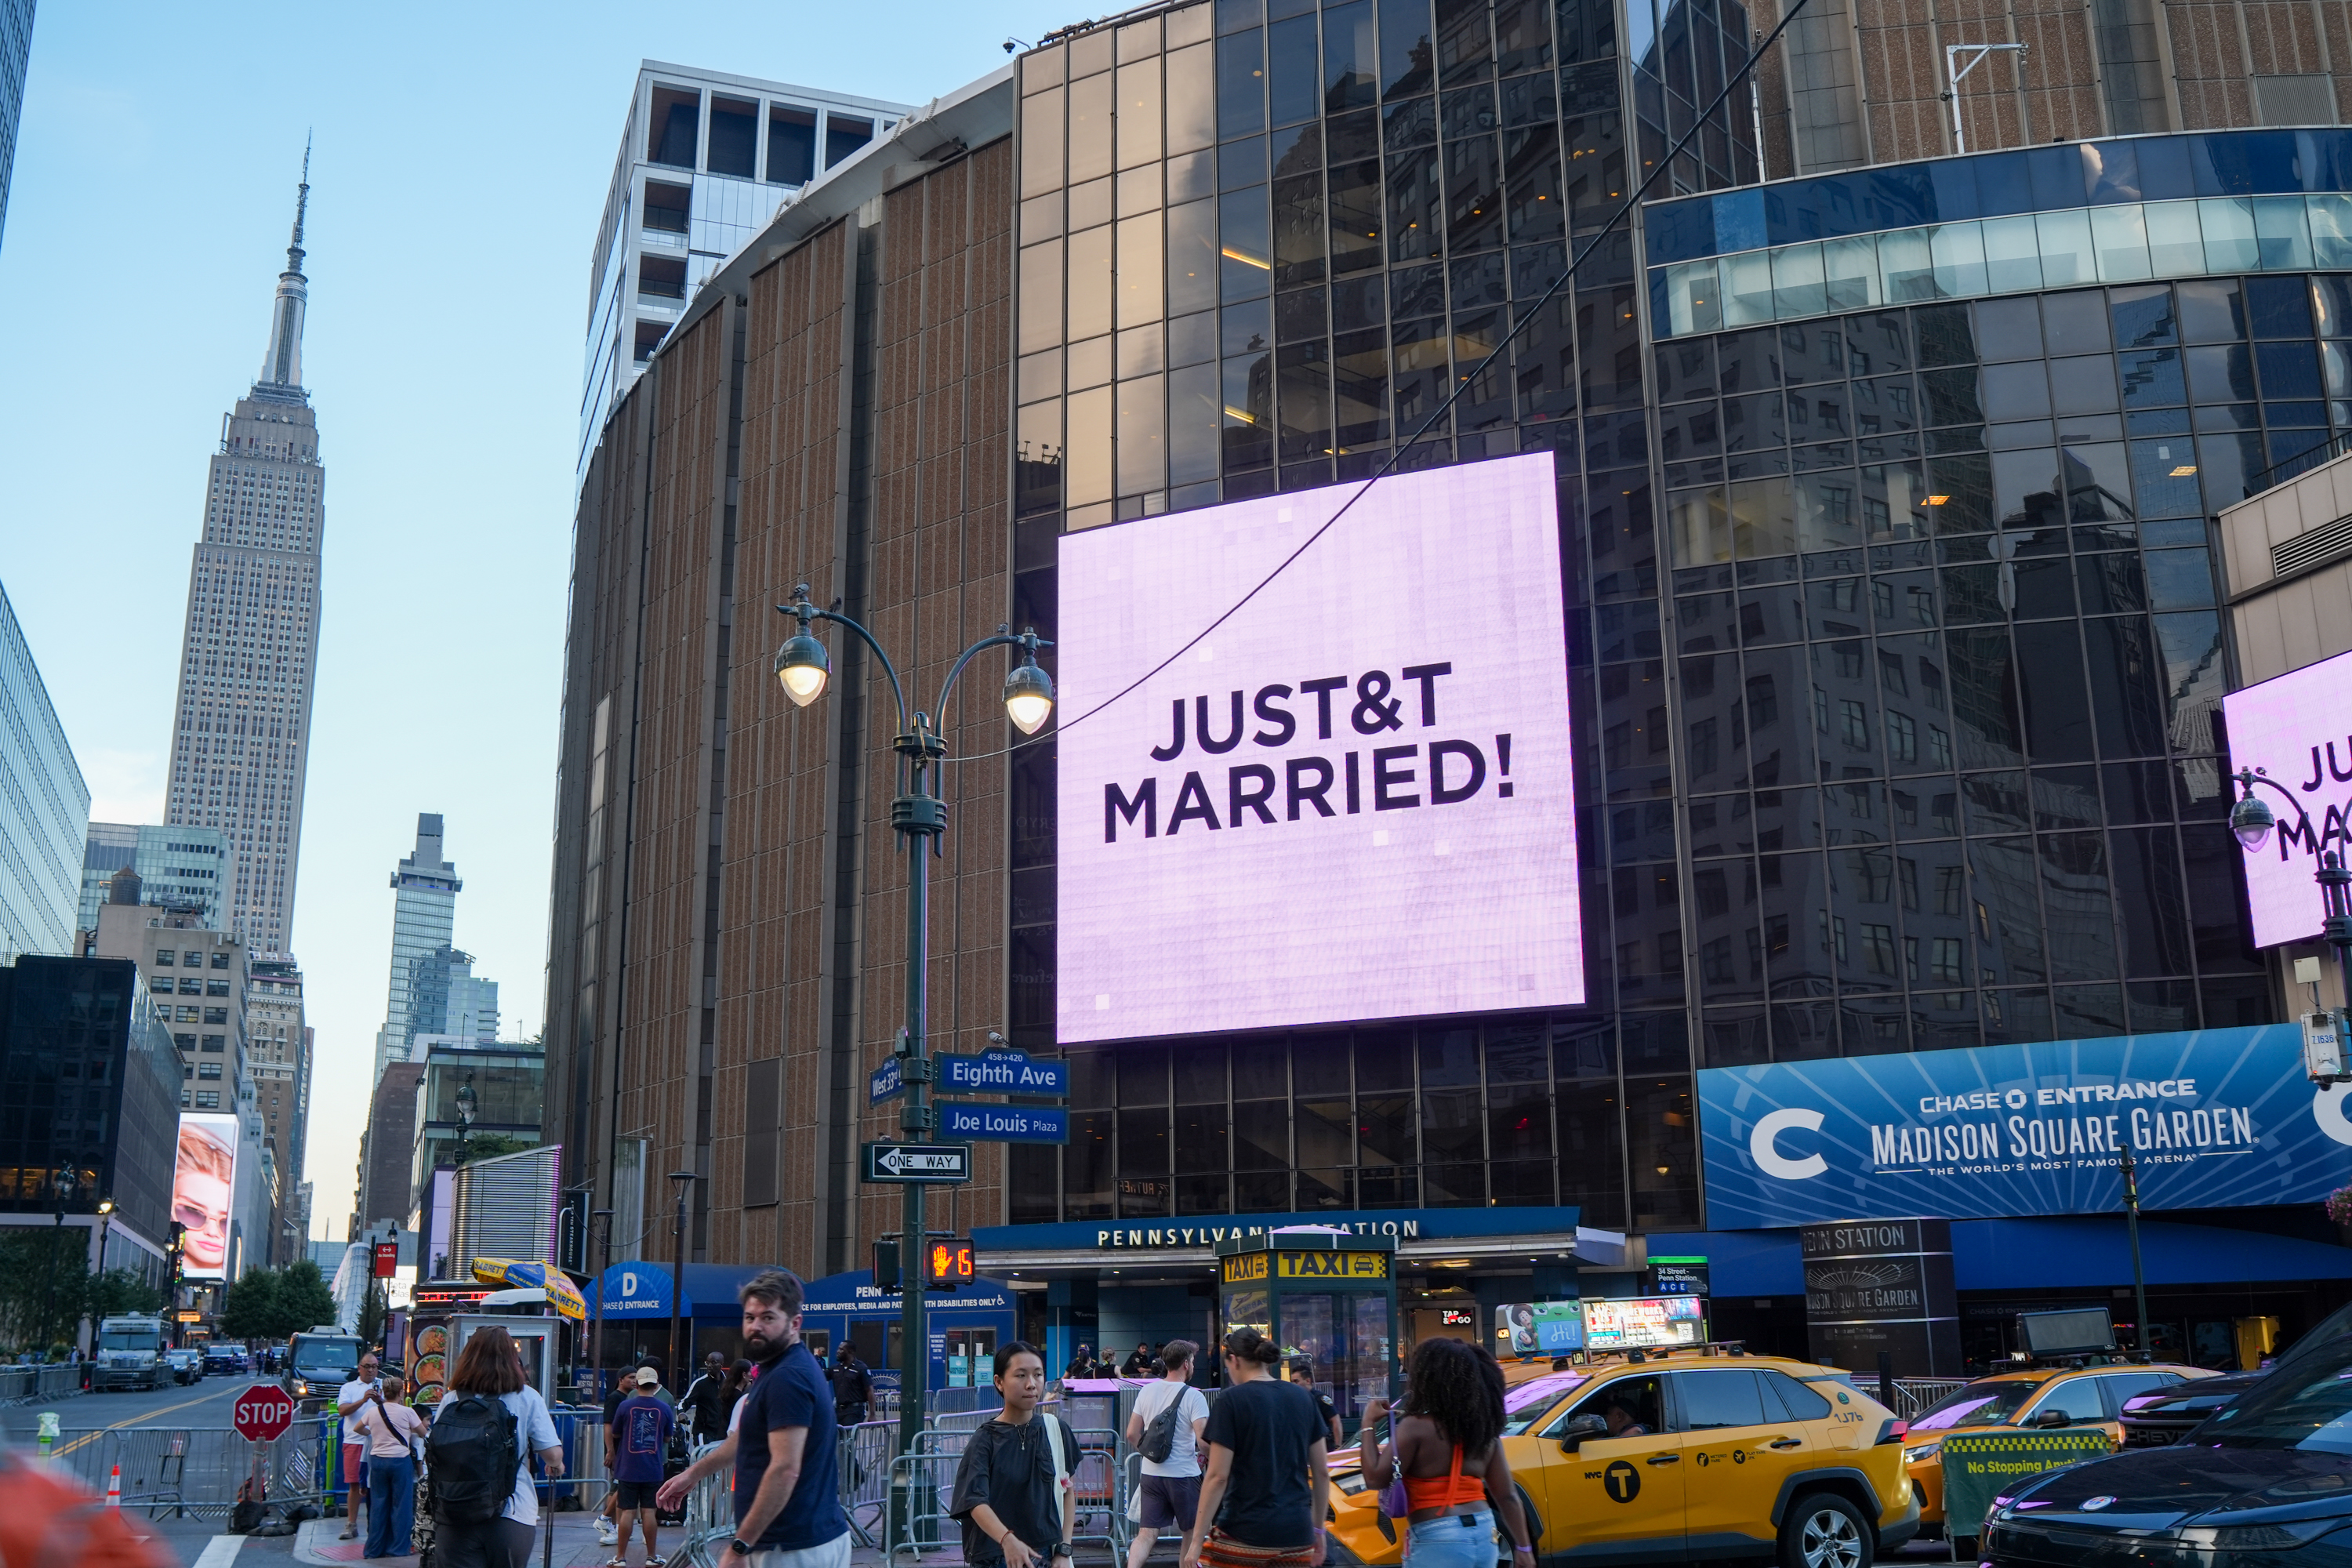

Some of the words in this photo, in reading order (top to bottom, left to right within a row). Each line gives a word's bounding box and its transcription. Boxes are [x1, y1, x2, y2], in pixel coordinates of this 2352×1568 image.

[1149, 661, 1452, 762] JUST&T
[1105, 733, 1513, 844] MARRIED!
[873, 1076, 887, 1097] West
[887, 1069, 898, 1091] 33rd
[953, 1062, 1014, 1087] Eighth
[1019, 1066, 1056, 1086] Ave
[1919, 1092, 2002, 1113] CHASE
[2037, 1078, 2197, 1105] ENTRANCE
[953, 1112, 980, 1131] Joe
[985, 1113, 1028, 1133] Louis
[1033, 1120, 1058, 1132] Plaza
[1750, 1108, 1829, 1180] C
[1871, 1123, 2000, 1165] MADISON
[2009, 1114, 2122, 1160] SQUARE
[888, 1155, 913, 1167] ONE
[925, 1156, 953, 1168] WAY
[1928, 1167, 1955, 1176] THE
[1960, 1162, 2024, 1174] WORLD'S
[2031, 1160, 2071, 1171] MOST
[1098, 1224, 1290, 1247] PENNSYLVAN
[1835, 1225, 1905, 1250] STATION
[474, 1261, 506, 1276] SABRETT
[1226, 1255, 1254, 1281] TAXI
[1283, 1252, 1348, 1276] TAXI
[384, 1281, 407, 1290] Meta
[391, 1289, 410, 1298] Glas
[622, 1272, 637, 1297] D
[855, 1287, 882, 1298] PENN
[546, 1287, 583, 1312] SABRETT
[625, 1299, 659, 1308] ENTRANCE
[822, 1302, 858, 1311] EMPLOYEES,
[877, 1301, 891, 1309] AND
[937, 1298, 978, 1308] DISABILITIES
[978, 1298, 996, 1306] ONLY
[1875, 1288, 1918, 1307] GARDEN
[1457, 1316, 1472, 1324] GO
[1550, 1323, 1577, 1343] Hi!
[237, 1403, 289, 1425] STOP
[1833, 1411, 1864, 1423] 1J76
[1584, 1471, 1602, 1480] NYC
[1967, 1461, 1985, 1474] No
[1987, 1460, 2042, 1475] Stopping
[1610, 1468, 1632, 1498] T
